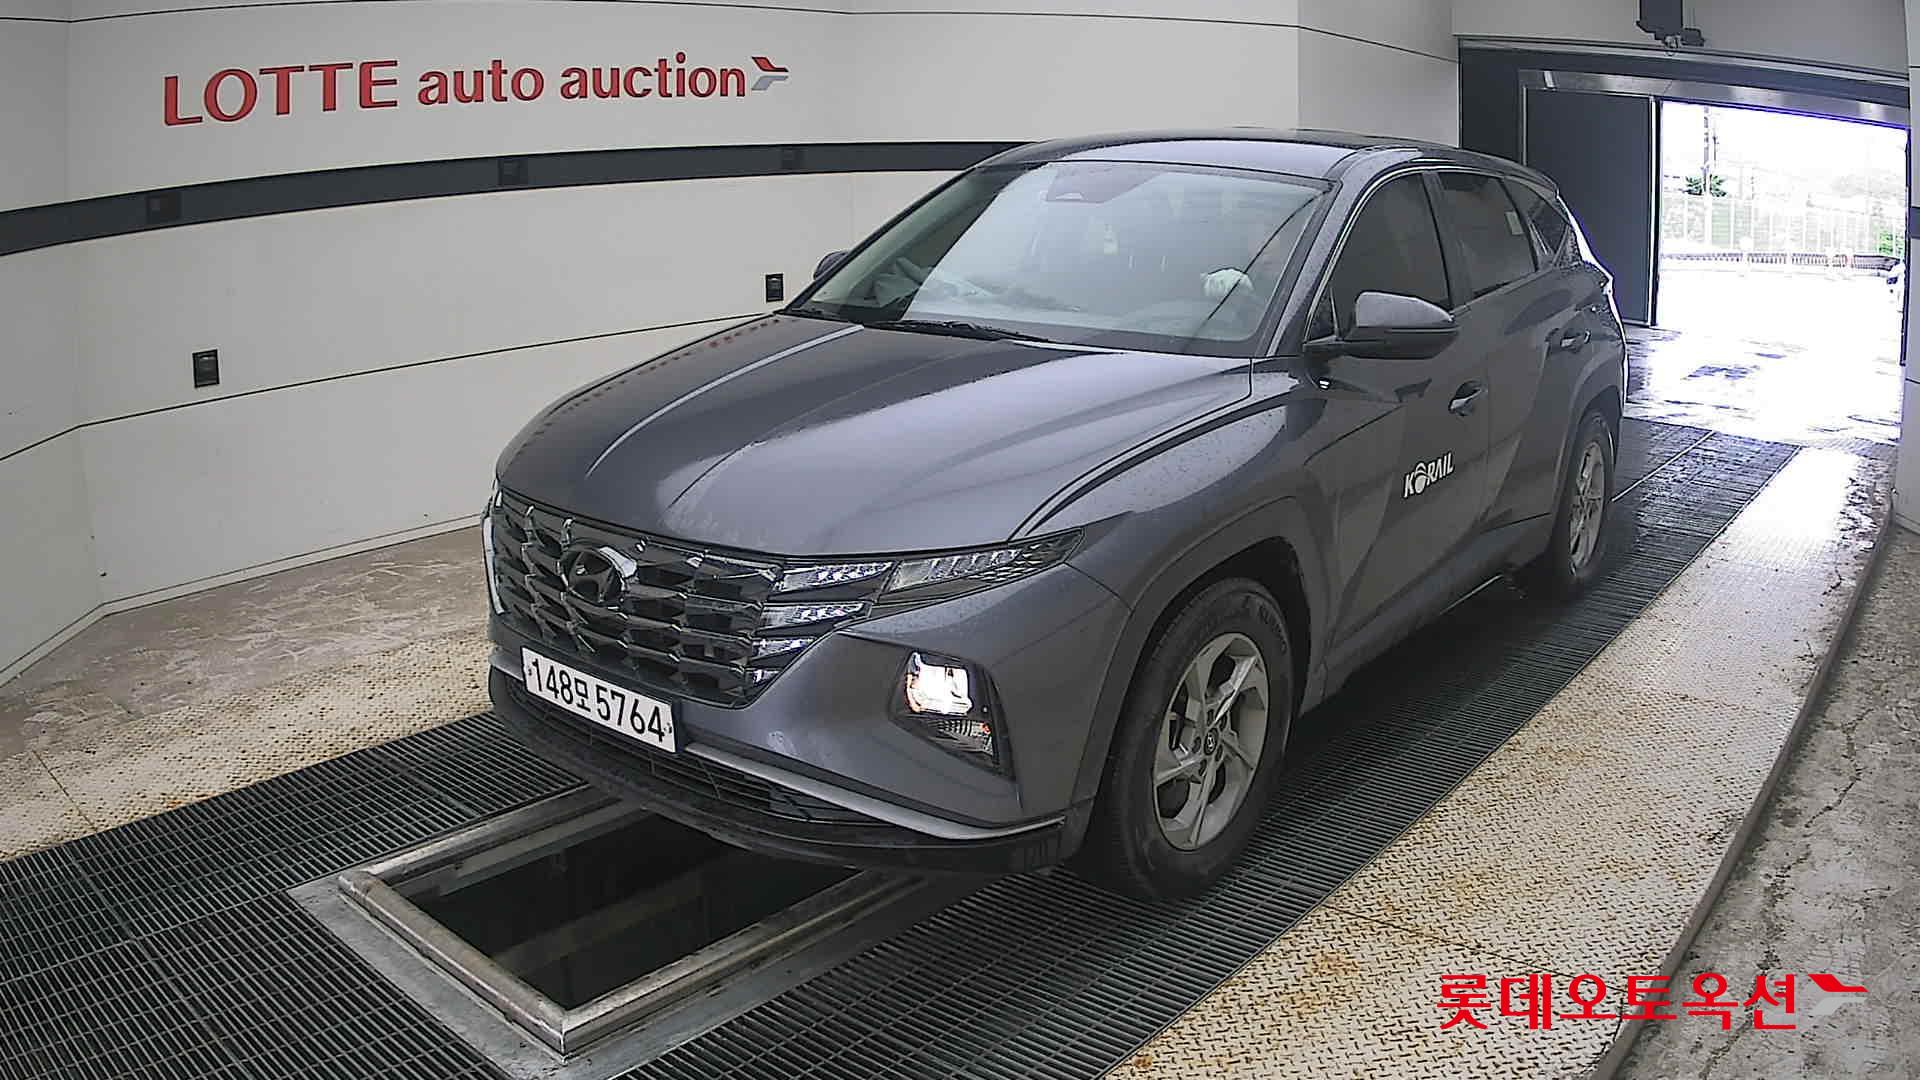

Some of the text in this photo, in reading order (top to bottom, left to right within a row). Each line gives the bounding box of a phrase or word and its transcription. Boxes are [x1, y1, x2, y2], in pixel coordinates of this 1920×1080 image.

[163, 52, 747, 126] LOTTE auto auction
[1403, 451, 1454, 498] KORAIL
